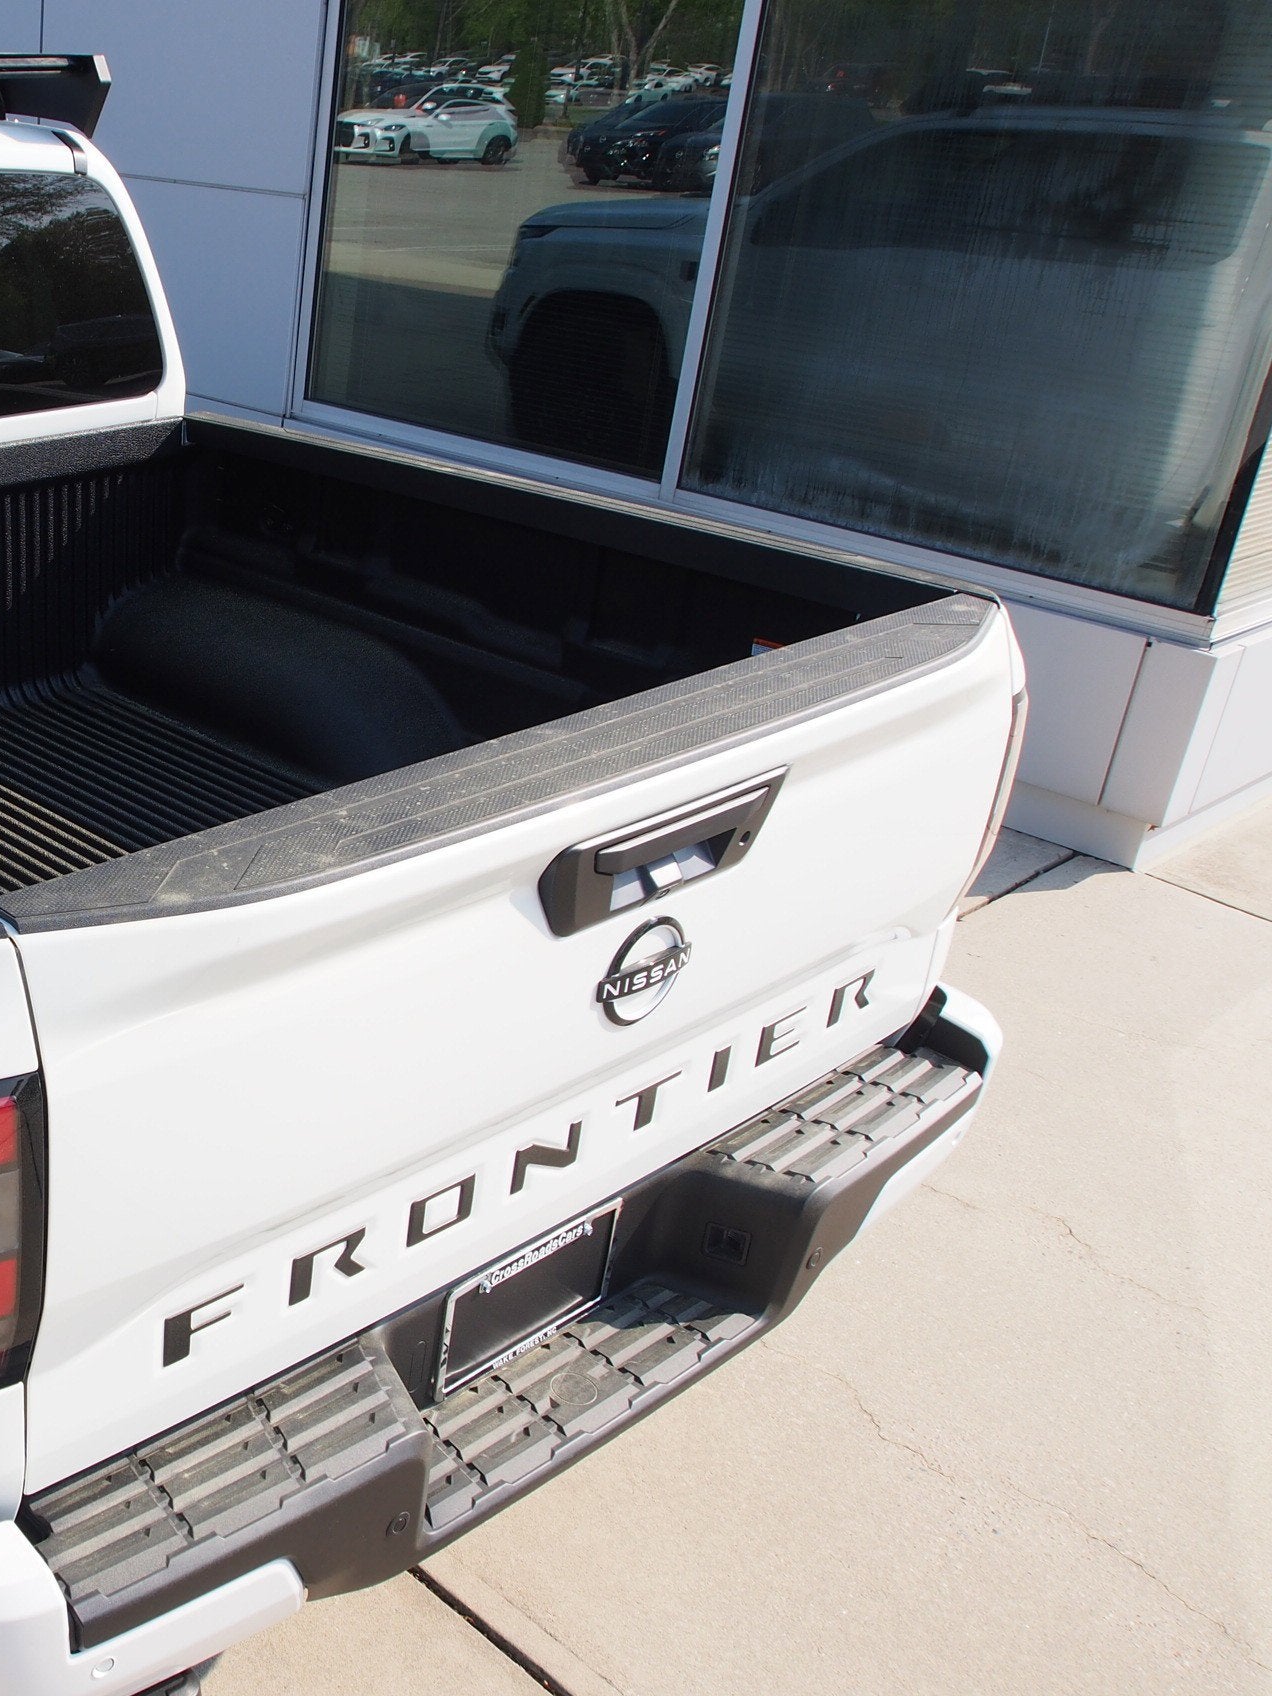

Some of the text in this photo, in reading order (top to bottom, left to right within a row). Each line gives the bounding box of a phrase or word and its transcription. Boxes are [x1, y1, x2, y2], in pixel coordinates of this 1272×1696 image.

[602, 947, 691, 999] NISSAN
[161, 966, 876, 1368] FRONTIER
[492, 1353, 514, 1369] WAKE
